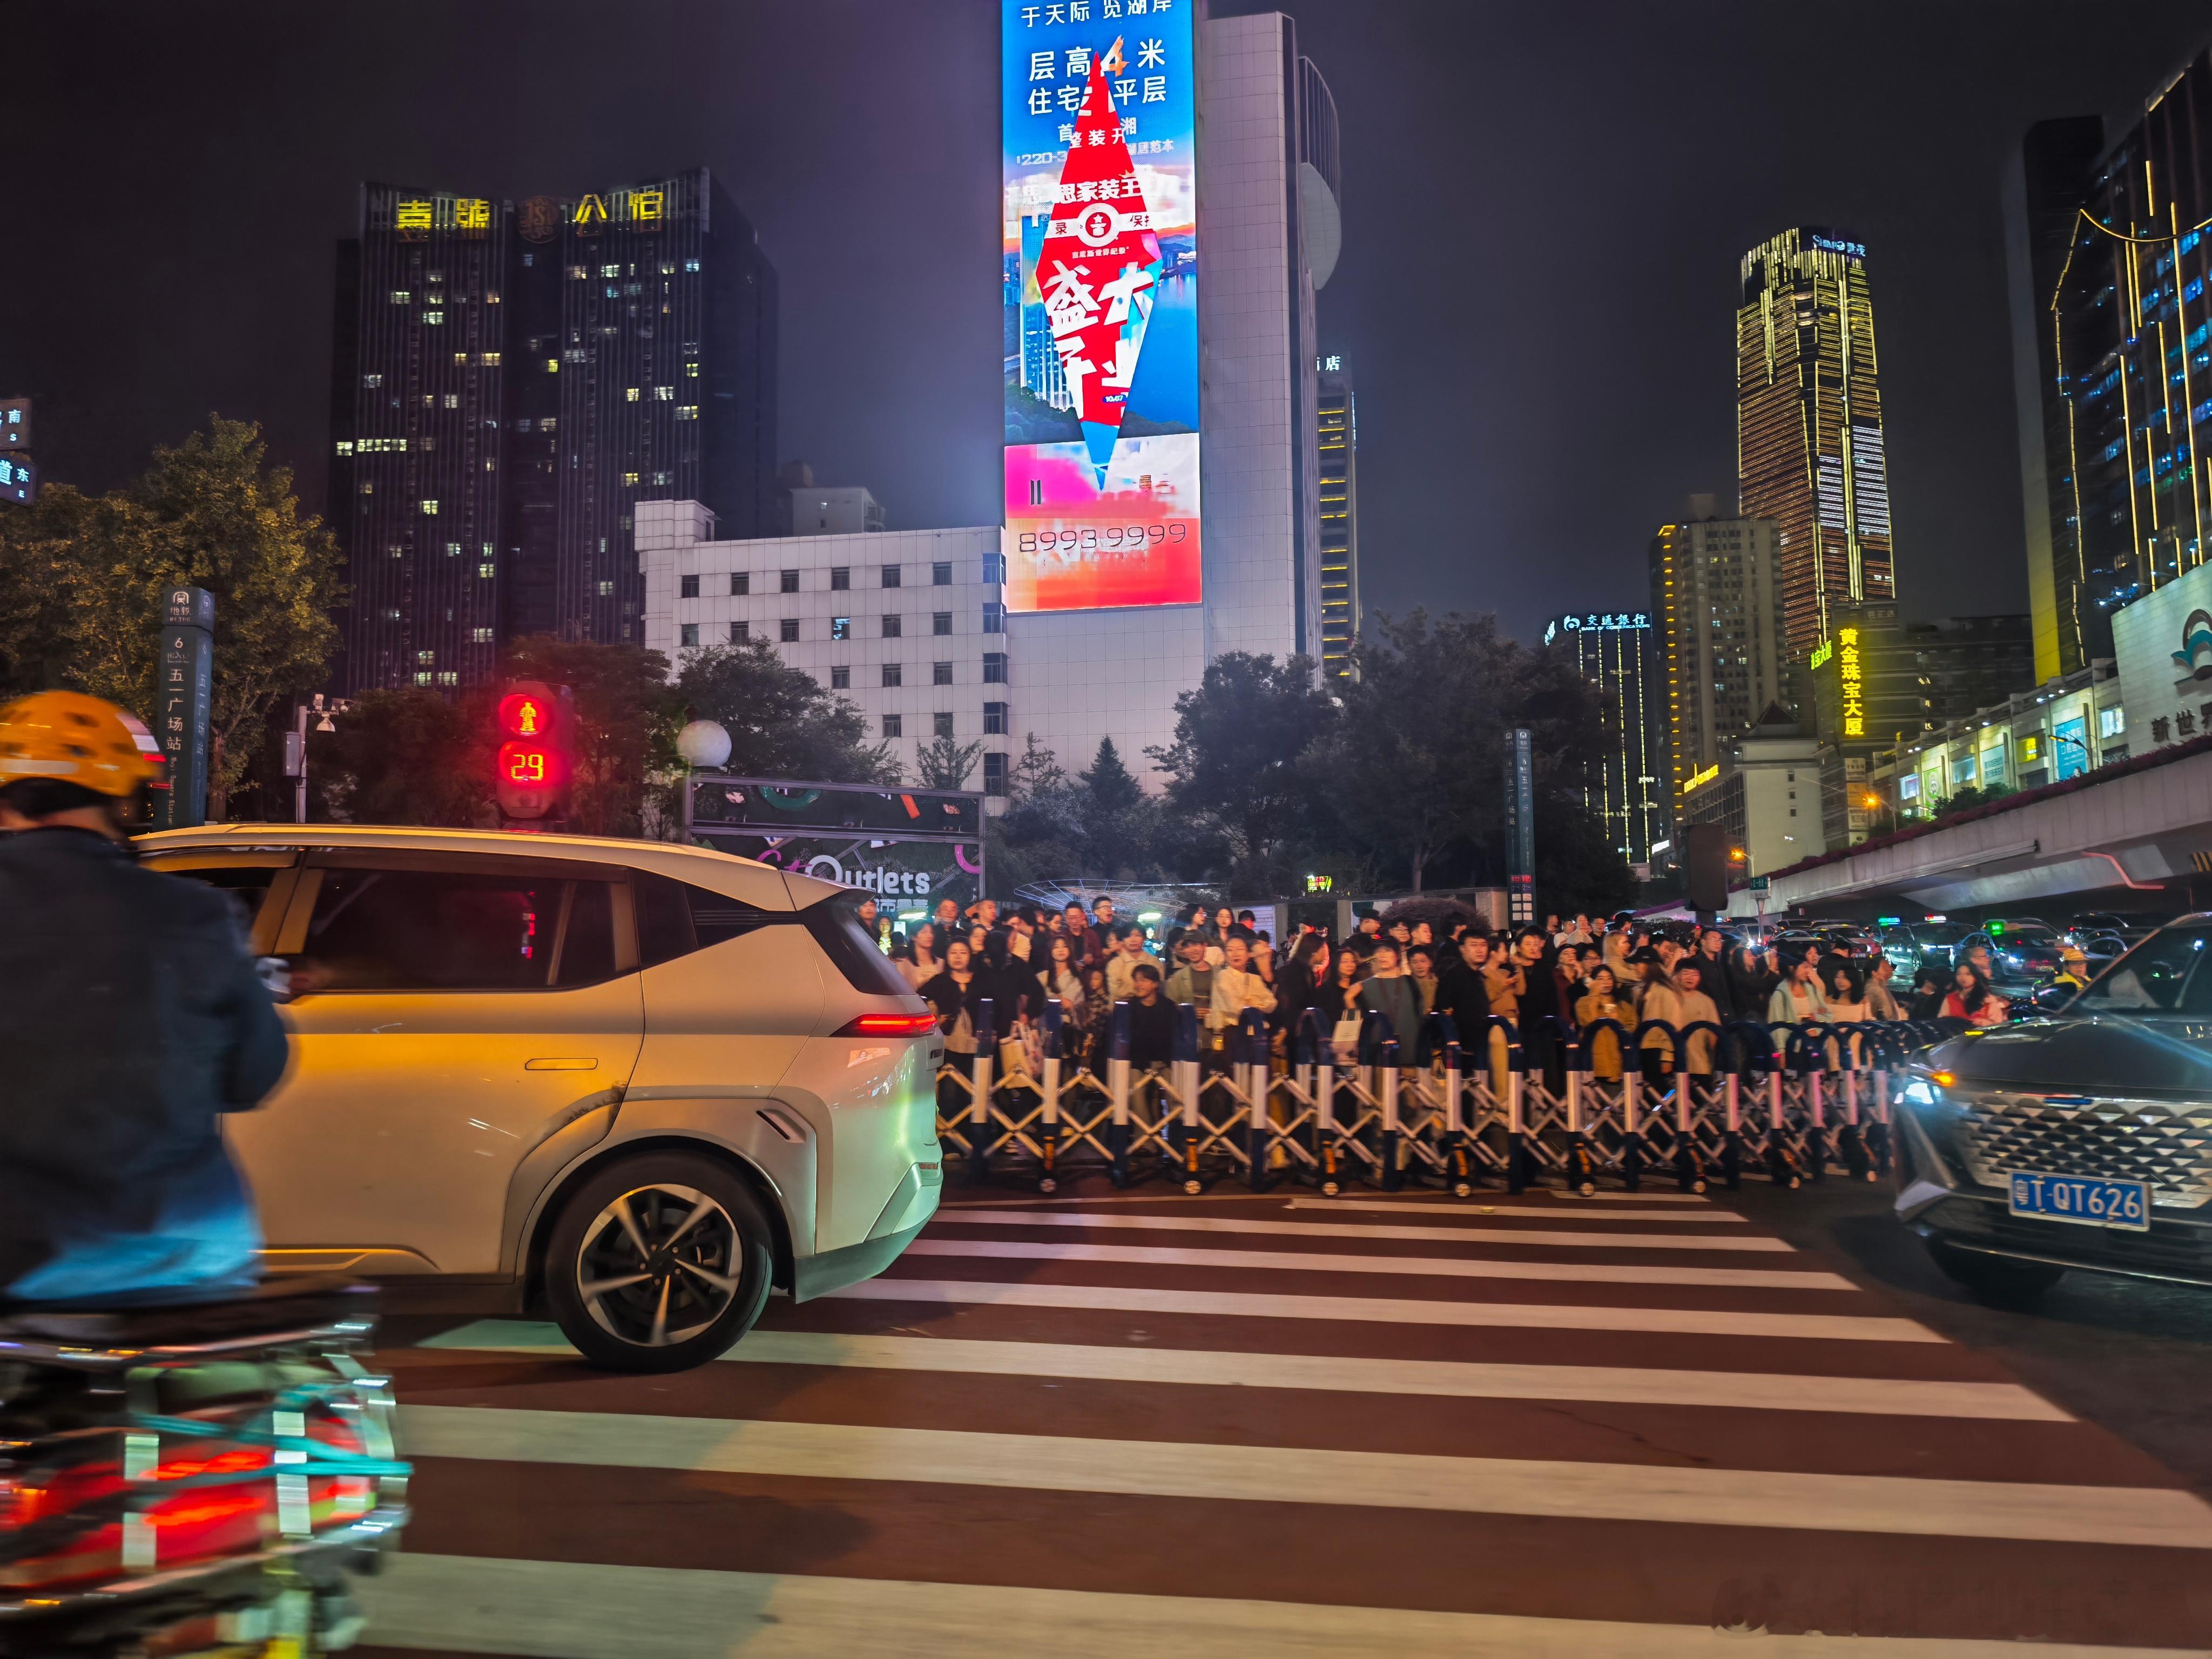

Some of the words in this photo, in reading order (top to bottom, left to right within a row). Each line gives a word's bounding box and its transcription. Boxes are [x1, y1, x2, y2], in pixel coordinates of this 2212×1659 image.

[1021, 2, 1090, 28] 于天际
[1028, 76, 1166, 116] 住宅平层
[8, 409, 22, 423] 南
[10, 433, 17, 441] S
[17, 468, 30, 482] 东
[18, 489, 25, 498] E
[1020, 528, 1097, 552] 8993
[1107, 524, 1186, 547] 9999
[174, 637, 184, 648] 6
[1839, 628, 1864, 735] 黄金珠宝大厦
[167, 669, 184, 751] 五一广场站
[510, 754, 544, 781] 29
[805, 854, 930, 895] Outlets
